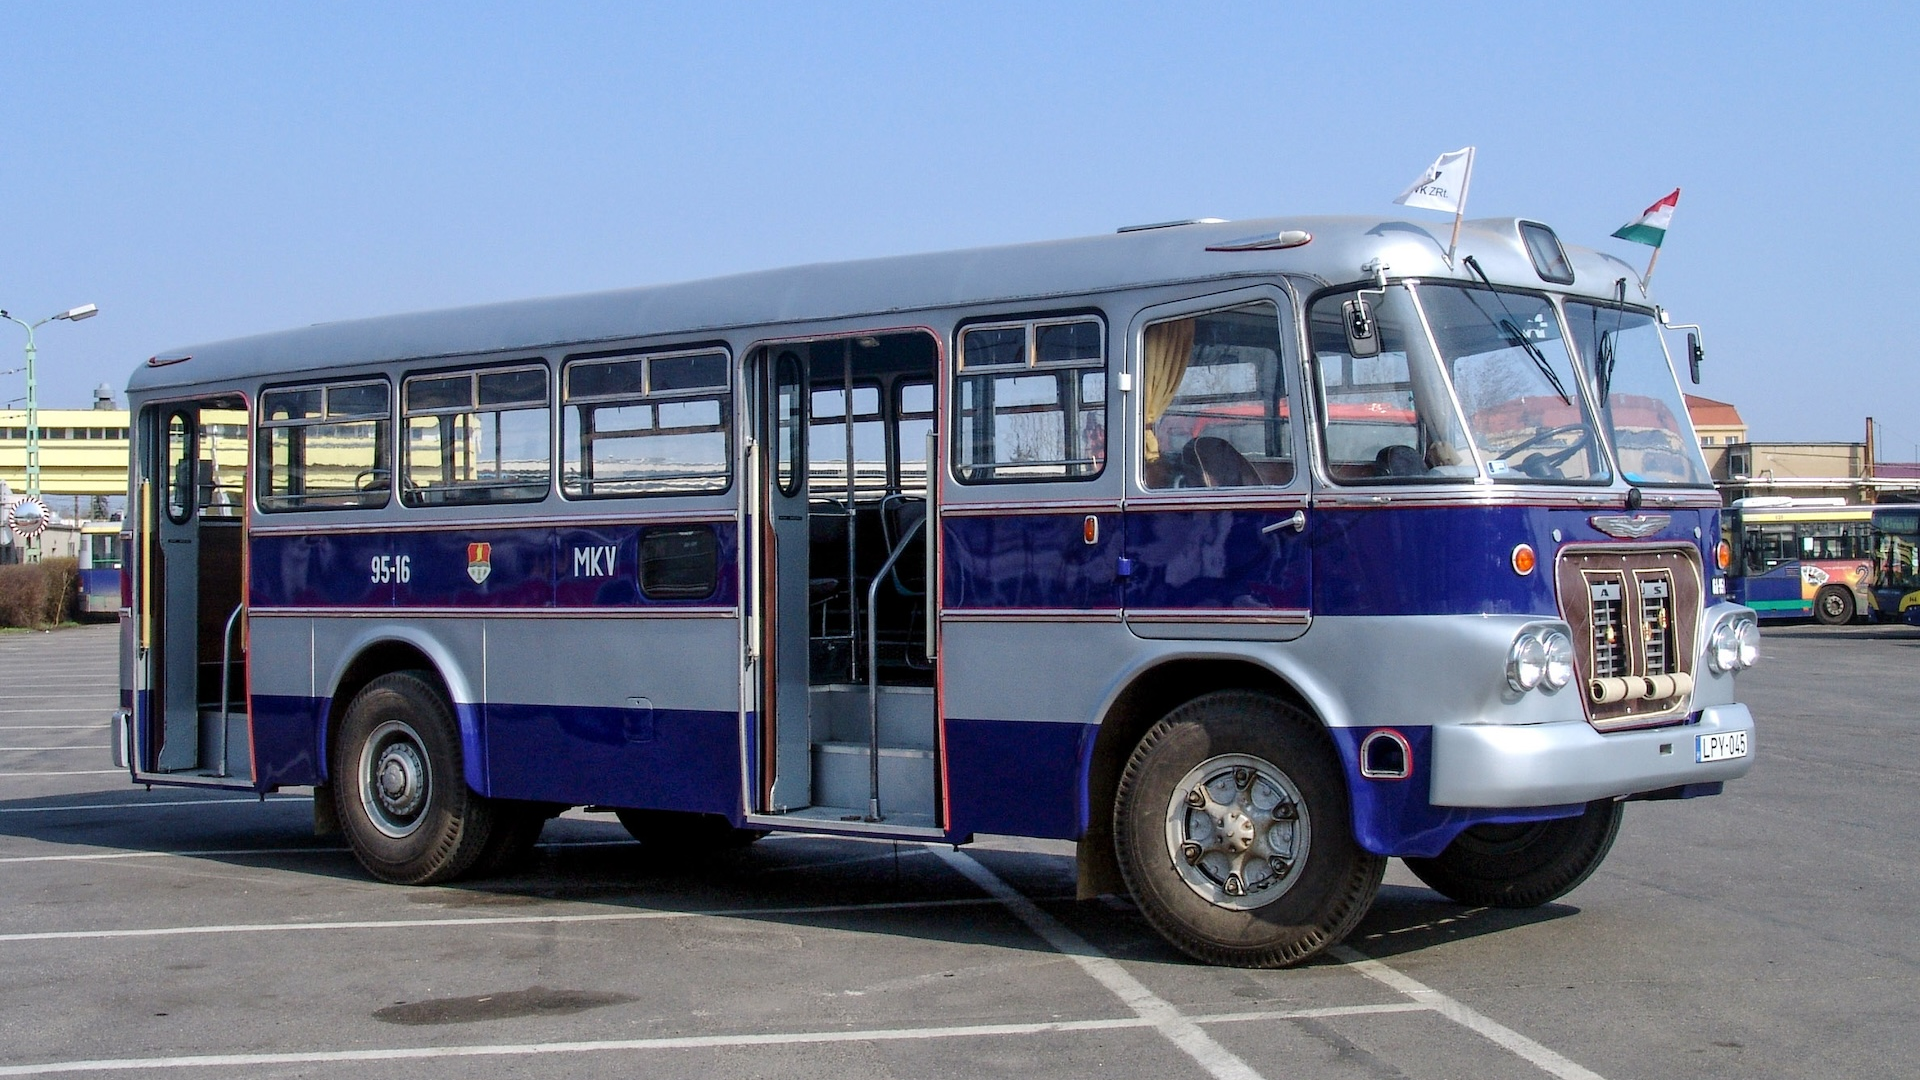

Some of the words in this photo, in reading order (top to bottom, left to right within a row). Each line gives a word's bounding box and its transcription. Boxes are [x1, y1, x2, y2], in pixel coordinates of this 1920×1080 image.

[371, 554, 411, 584] 95-16
[574, 545, 617, 578] MKV
[1703, 733, 1746, 759] LPY-045
